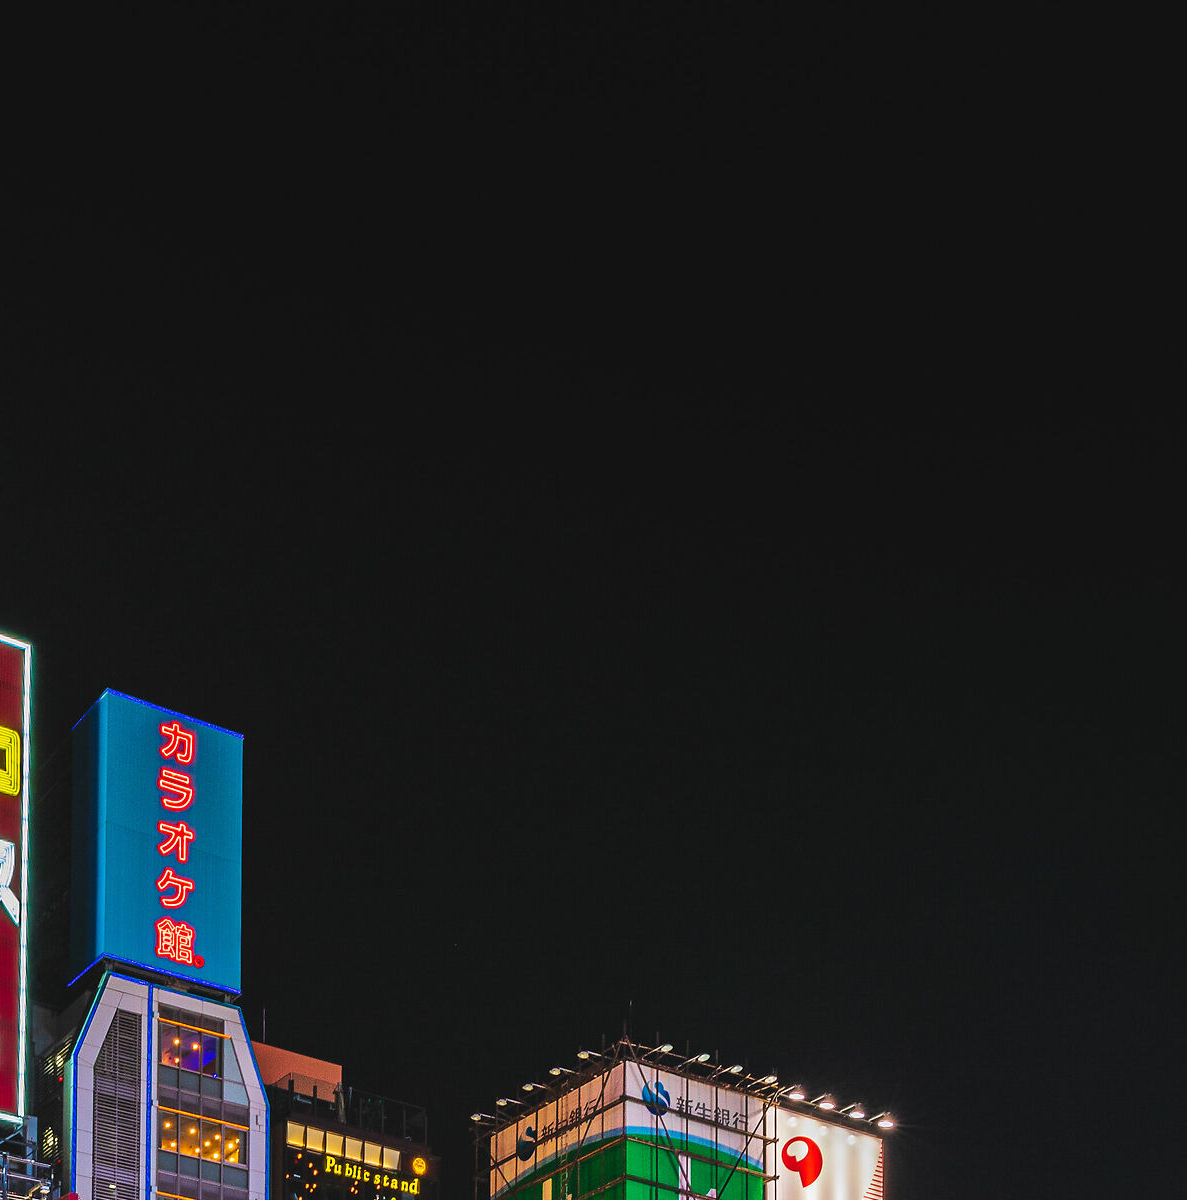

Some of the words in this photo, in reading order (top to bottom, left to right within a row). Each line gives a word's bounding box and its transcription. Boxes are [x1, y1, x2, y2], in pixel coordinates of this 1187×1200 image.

[157, 720, 196, 966] カラオケ館
[676, 1096, 749, 1131] 新生銀行
[325, 1156, 370, 1182] Public
[374, 1174, 420, 1195] stand
